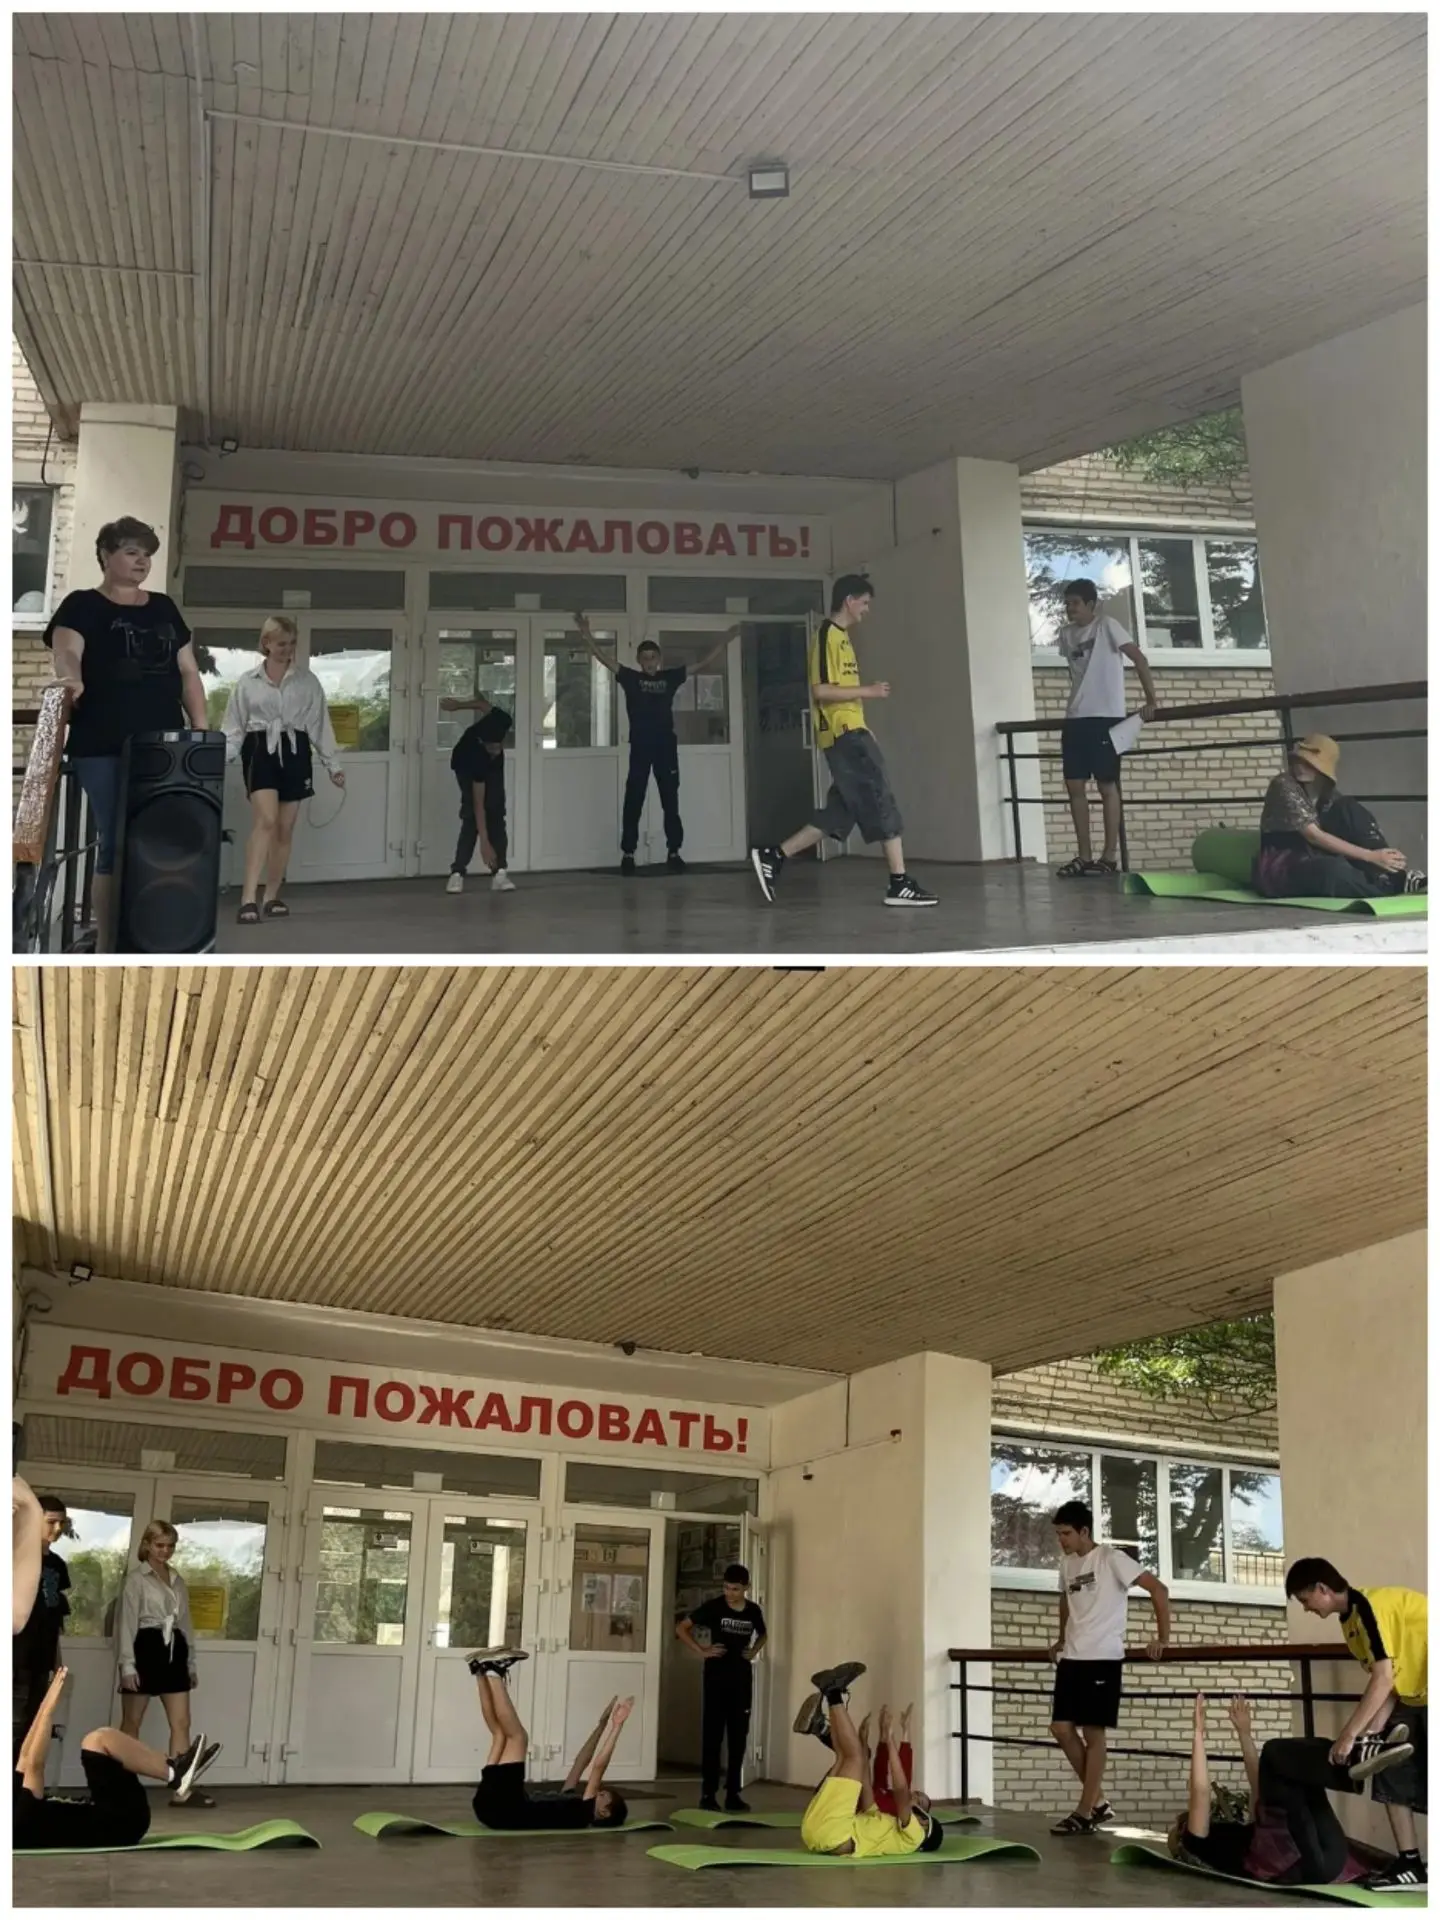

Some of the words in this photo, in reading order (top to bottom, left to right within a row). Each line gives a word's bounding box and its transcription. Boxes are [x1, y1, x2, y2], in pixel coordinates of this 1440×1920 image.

[210, 504, 418, 550] ДОБРО
[437, 513, 811, 559] ПОЖАЛОВАТЬ!
[56, 1345, 305, 1412] ДОБРО
[326, 1375, 749, 1455] ПОЖАЛОВАТЬ!
